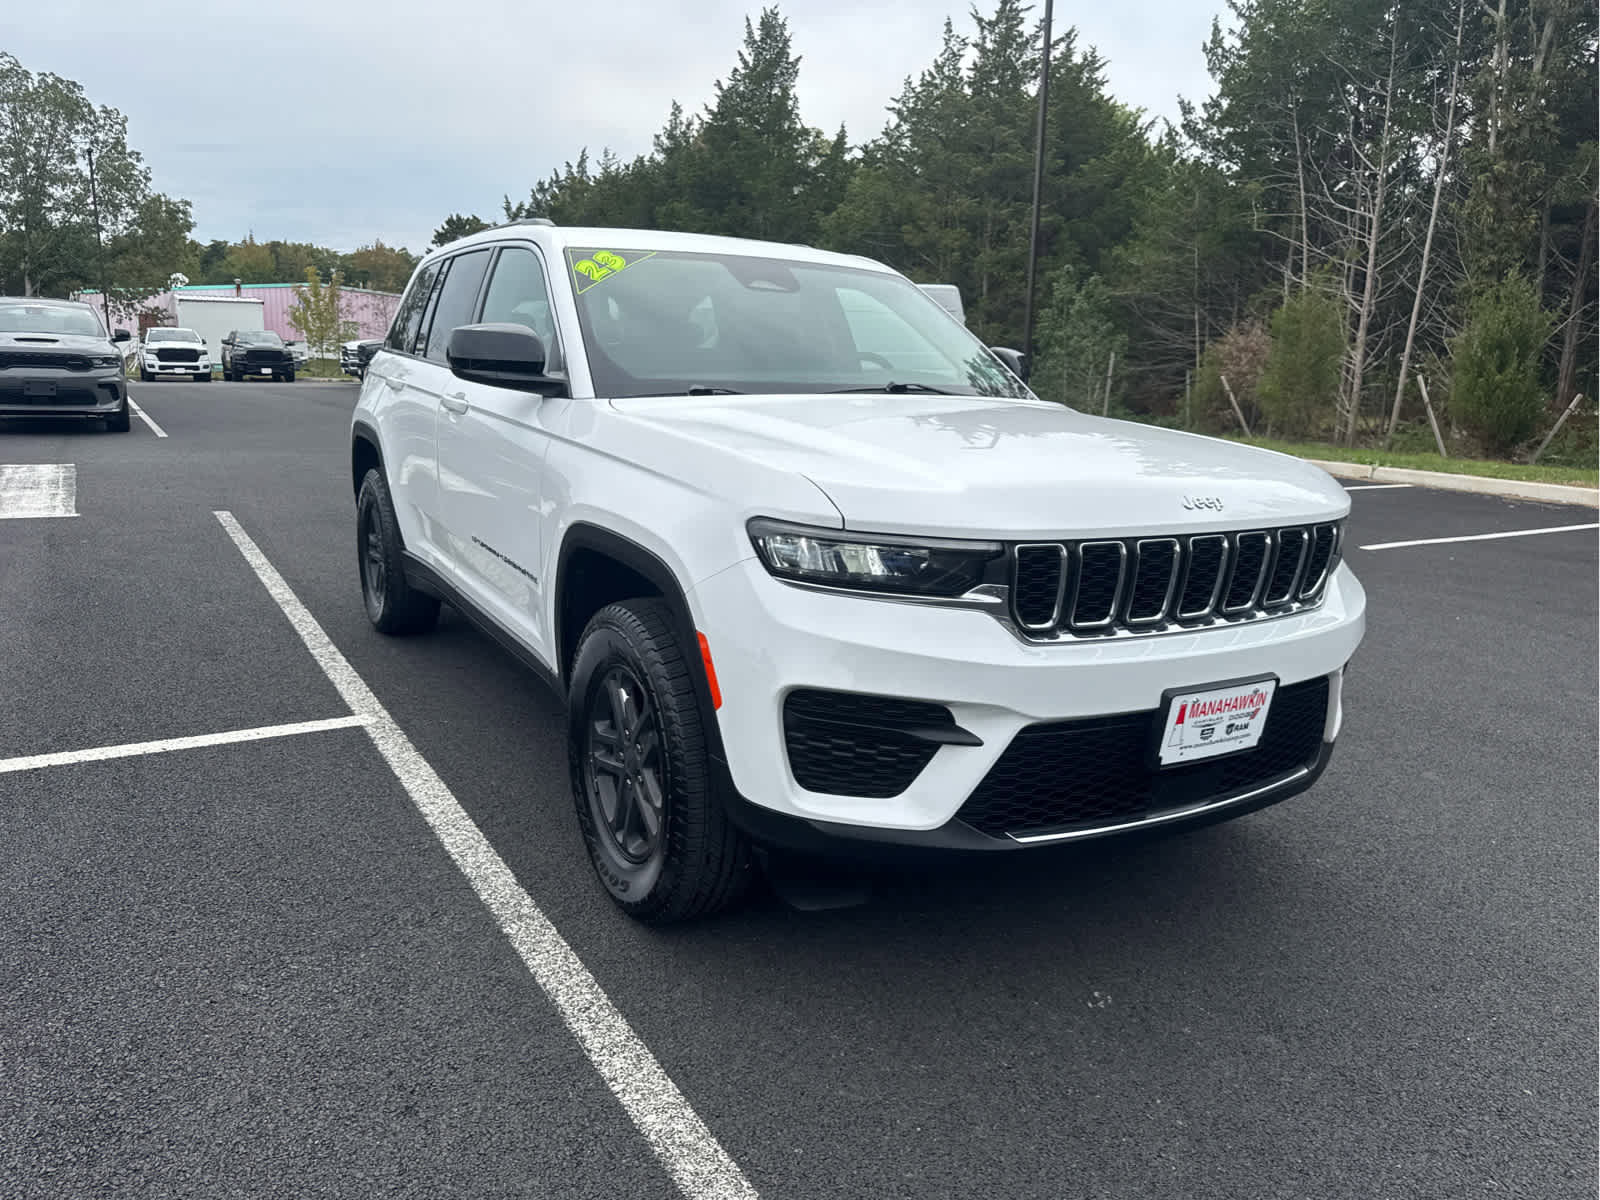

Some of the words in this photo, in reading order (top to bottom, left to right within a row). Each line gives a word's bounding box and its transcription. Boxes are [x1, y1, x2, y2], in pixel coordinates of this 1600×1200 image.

[575, 250, 626, 281] 23
[1182, 495, 1224, 512] Jeep
[1188, 691, 1268, 719] MANAHAWKIN
[1233, 721, 1250, 732] RAM
